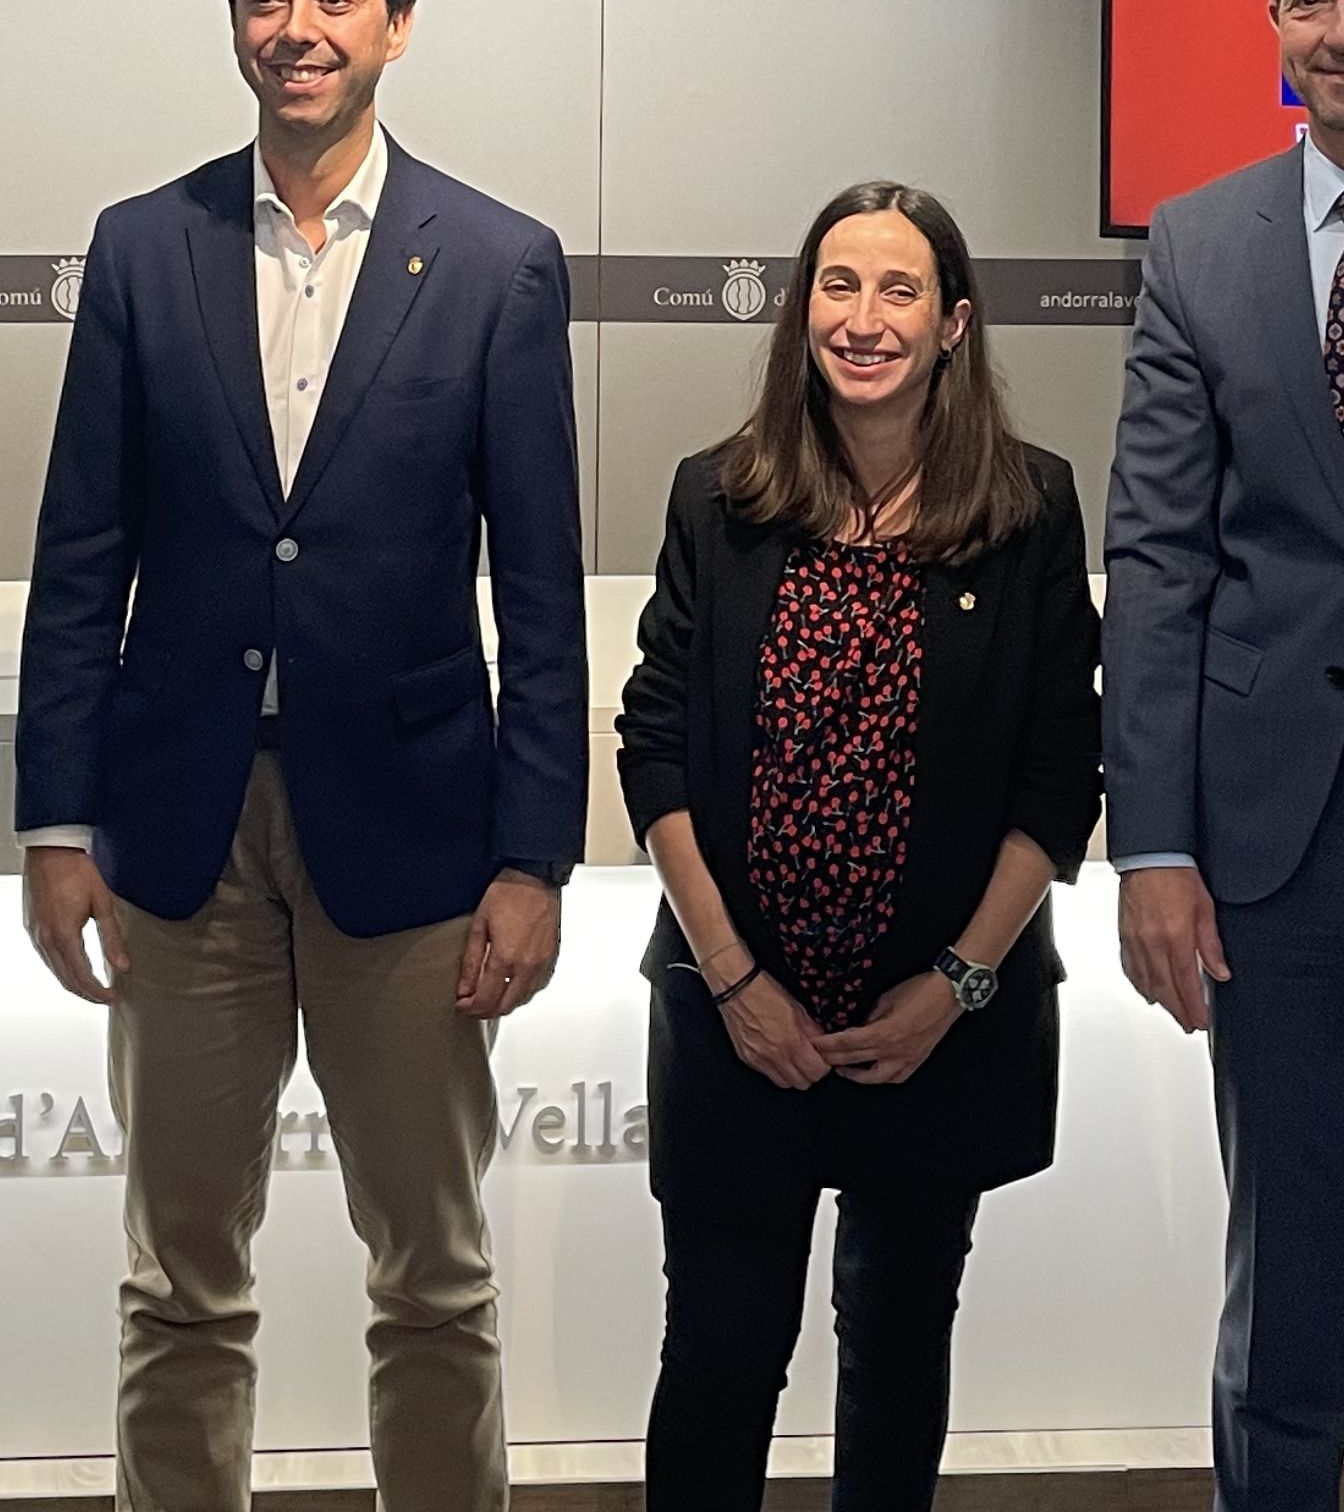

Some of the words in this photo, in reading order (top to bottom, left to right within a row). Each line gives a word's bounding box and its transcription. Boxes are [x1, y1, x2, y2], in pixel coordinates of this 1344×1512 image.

[653, 287, 714, 307] Comú
[1040, 291, 1138, 308] andorralav
[498, 1080, 648, 1156] Vella
